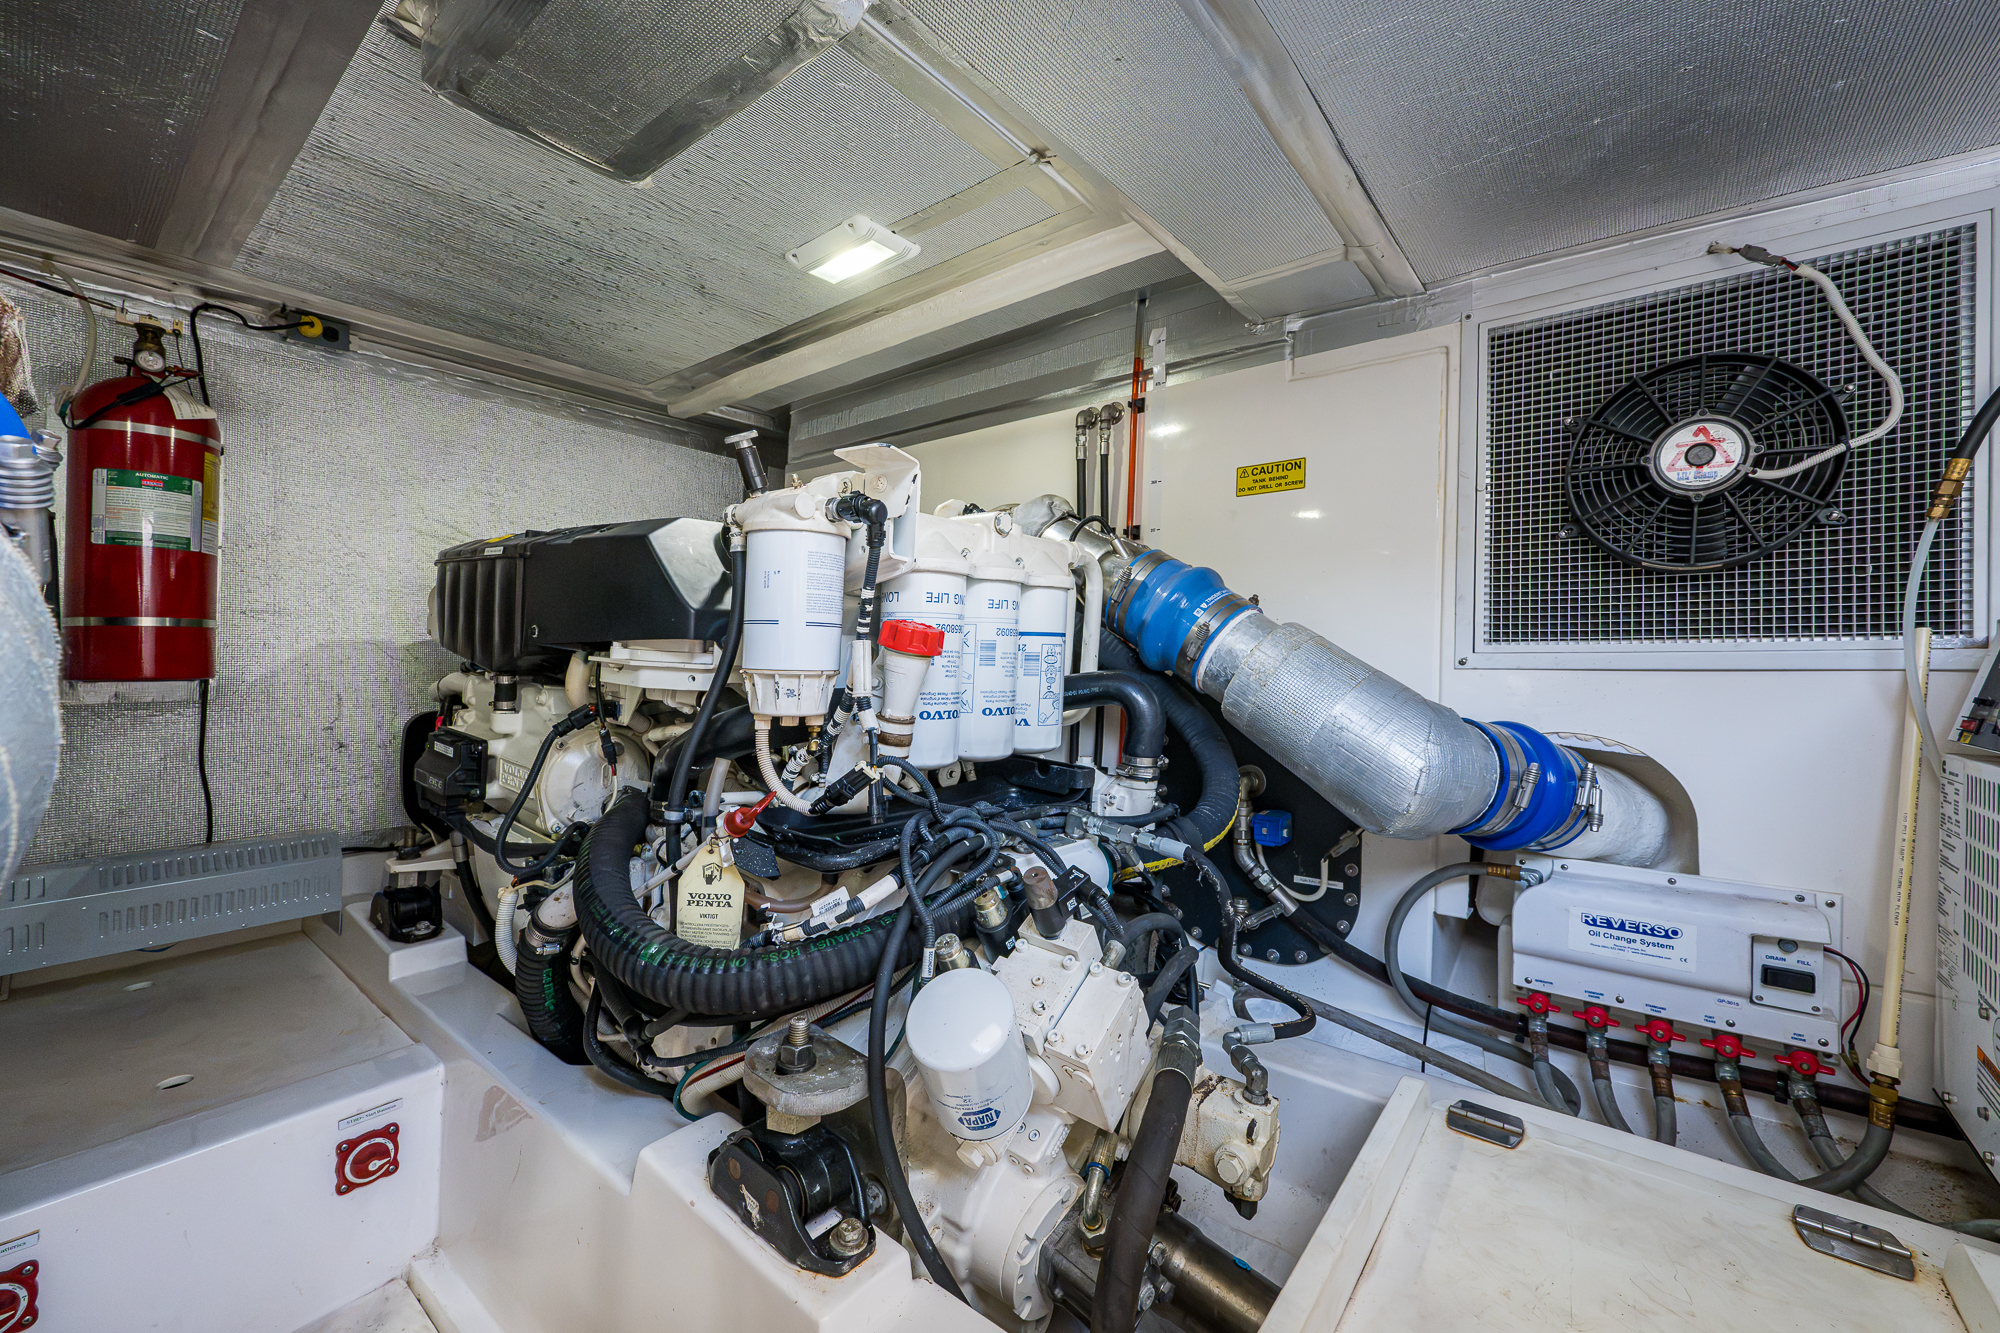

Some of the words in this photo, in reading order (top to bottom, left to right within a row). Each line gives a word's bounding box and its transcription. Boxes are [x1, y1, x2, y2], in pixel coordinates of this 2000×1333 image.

[1251, 461, 1302, 476] CAUTION
[135, 472, 169, 480] AUTOMATIC
[1284, 479, 1304, 487] SCREW
[925, 591, 950, 604] LIFE
[987, 598, 1009, 610] LIFE
[918, 709, 961, 720] OLVO
[981, 706, 1016, 717] OLVO
[502, 773, 525, 789] PENT
[687, 892, 732, 901] VOLVO
[686, 899, 733, 908] PENTA
[1580, 912, 1684, 939] REVERSO
[808, 925, 872, 953] EXHAUST
[1588, 929, 1601, 938] Oil
[1602, 931, 1638, 945] Change
[1639, 938, 1675, 951] System
[1765, 954, 1787, 962] DRAIN
[1716, 998, 1740, 1007] GP-3015
[963, 1112, 995, 1127] NAPA
[0, 1241, 27, 1254] atteries
